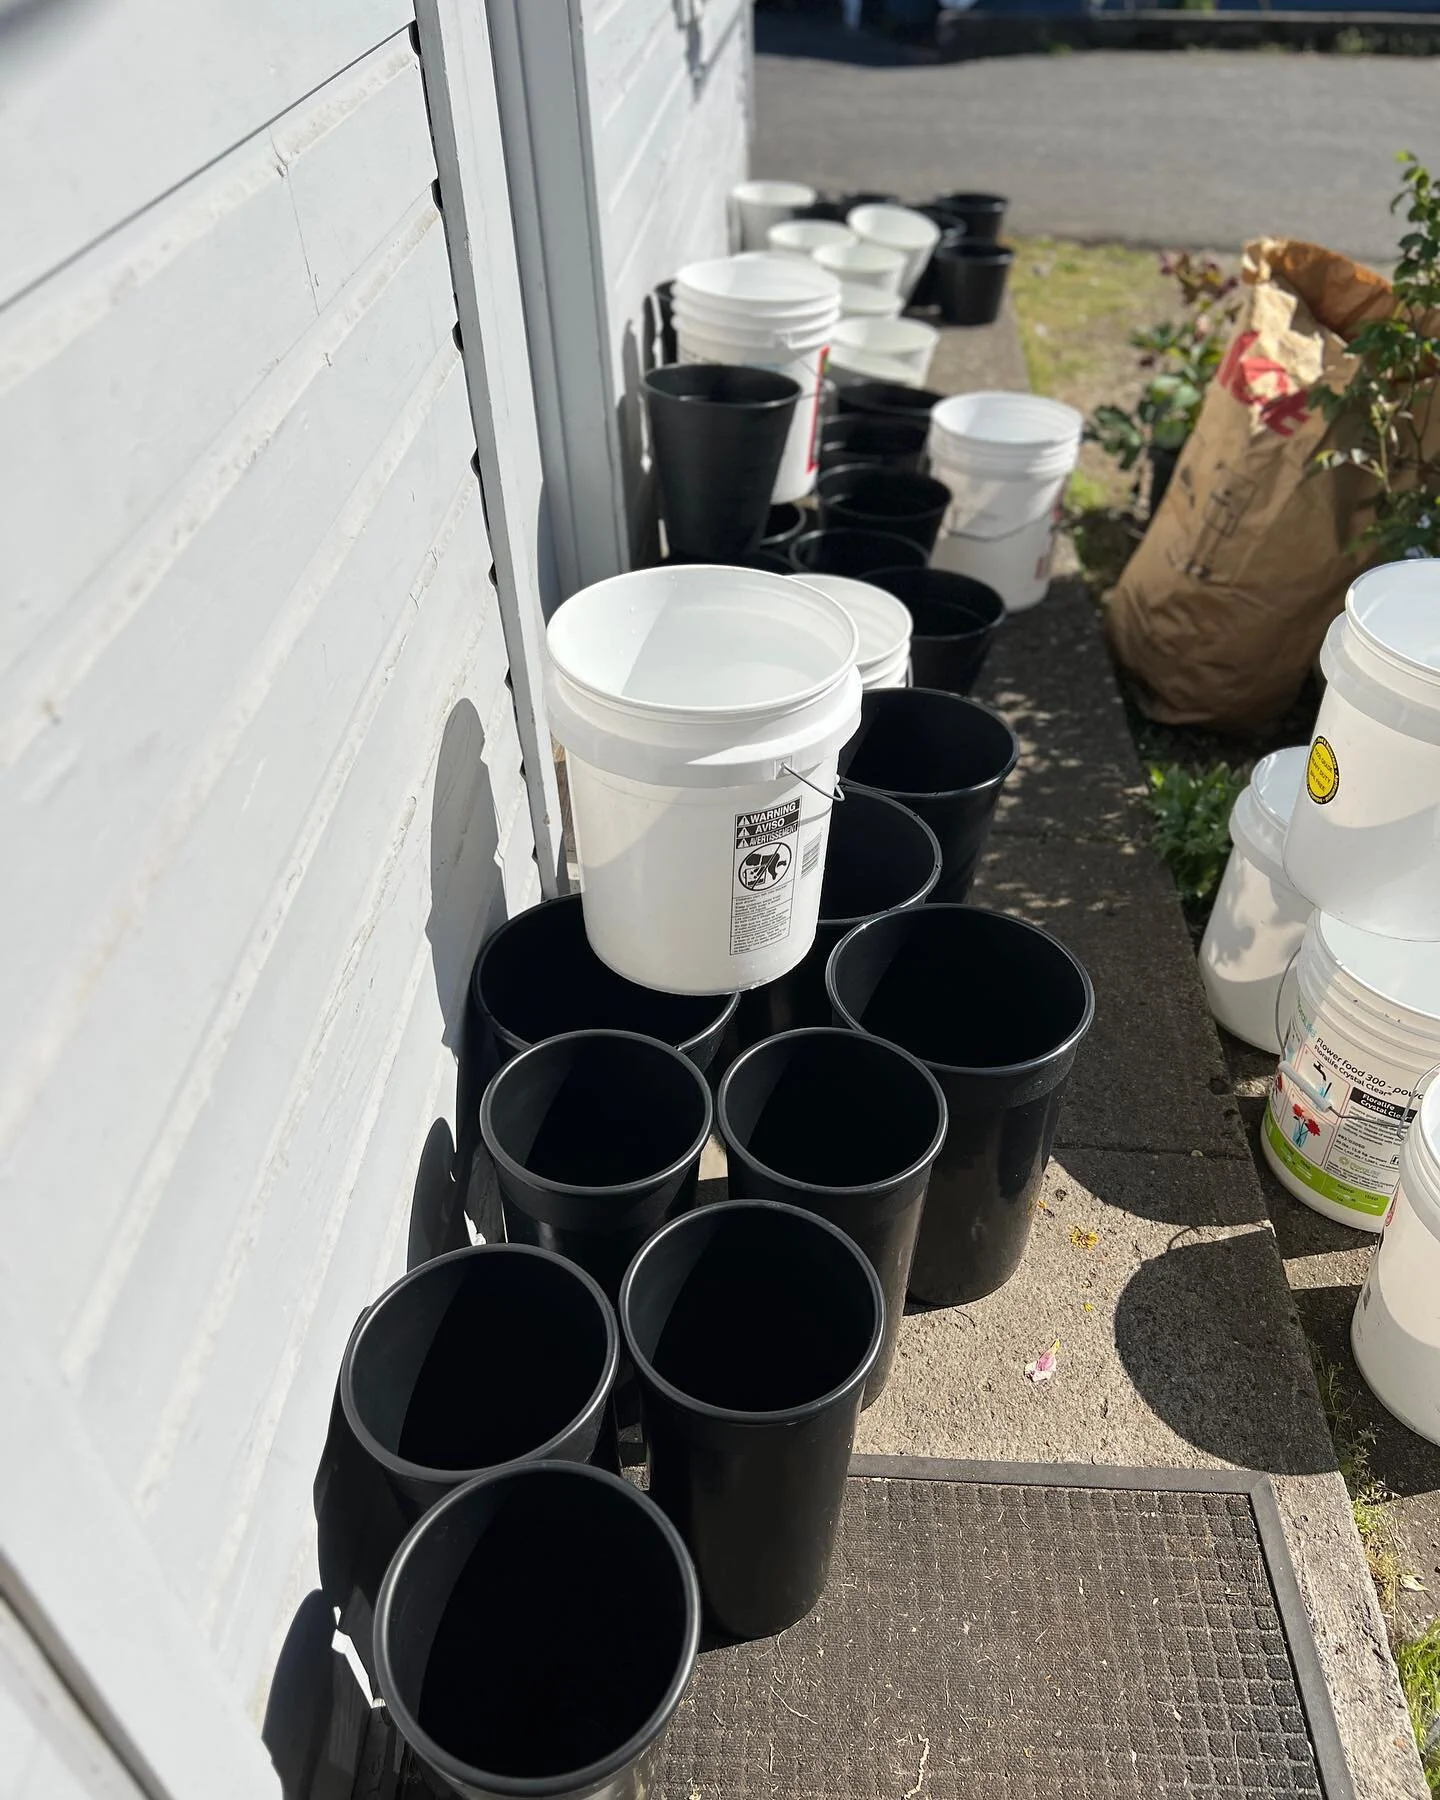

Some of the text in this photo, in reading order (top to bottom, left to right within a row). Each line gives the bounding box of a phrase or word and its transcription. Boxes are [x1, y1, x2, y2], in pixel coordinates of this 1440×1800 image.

[750, 802, 796, 824] WARNING
[750, 822, 798, 846] AVERTISSEMENT
[755, 817, 785, 834] AVISO
[1314, 1044, 1339, 1070] Floralife
[1338, 1066, 1365, 1087] Crystal
[1316, 1037, 1342, 1063] Flower
[1341, 1059, 1366, 1078] food
[1365, 1073, 1386, 1088] 300
[1360, 1099, 1388, 1116] Crystal
[1362, 1093, 1396, 1111] Floralife
